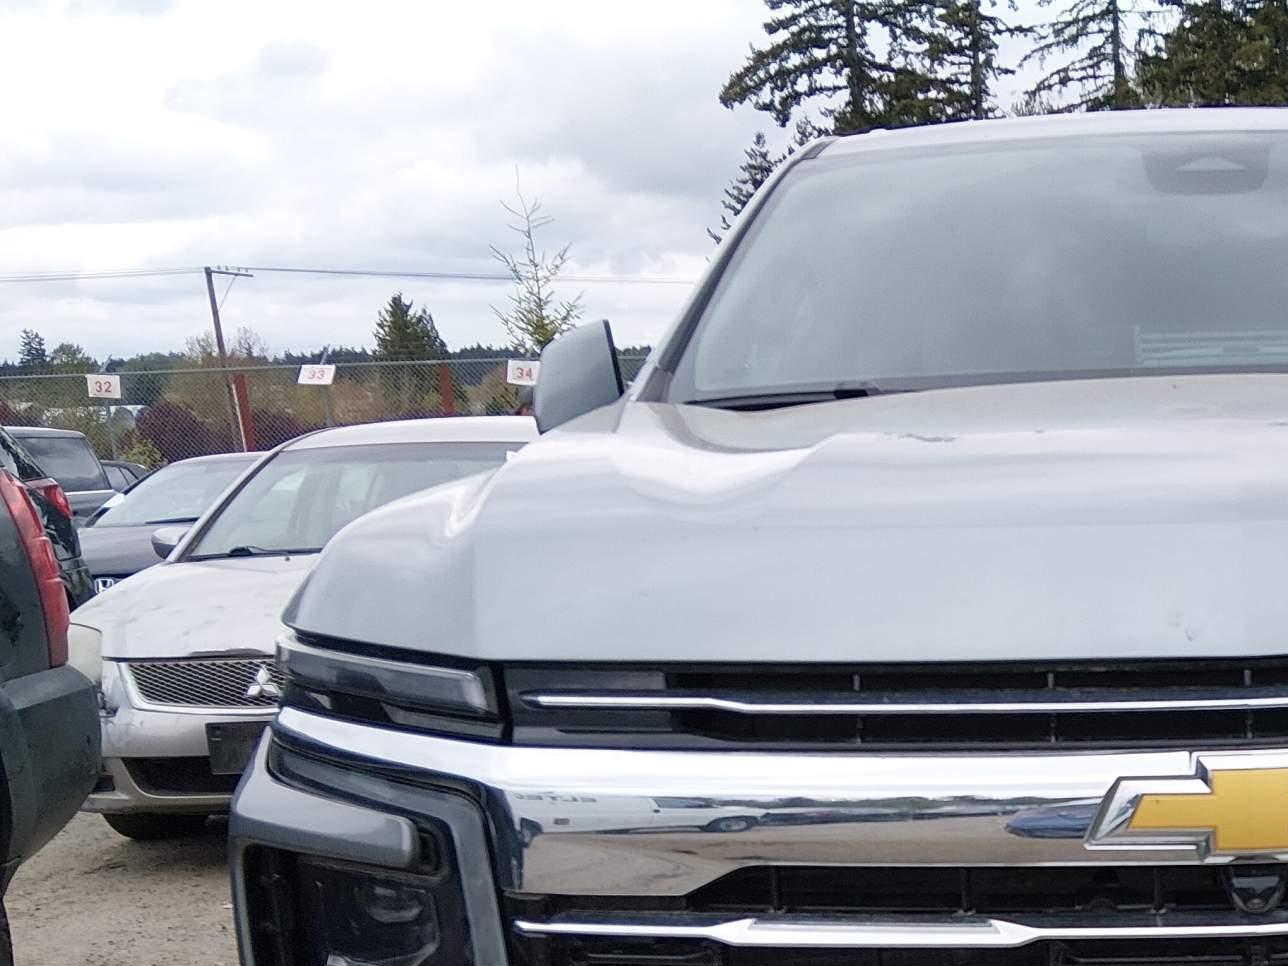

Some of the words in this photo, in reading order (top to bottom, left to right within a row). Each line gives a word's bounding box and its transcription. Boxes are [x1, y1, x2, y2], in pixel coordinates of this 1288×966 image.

[308, 368, 325, 380] 33
[516, 367, 532, 379] 34
[95, 380, 111, 393] 32
